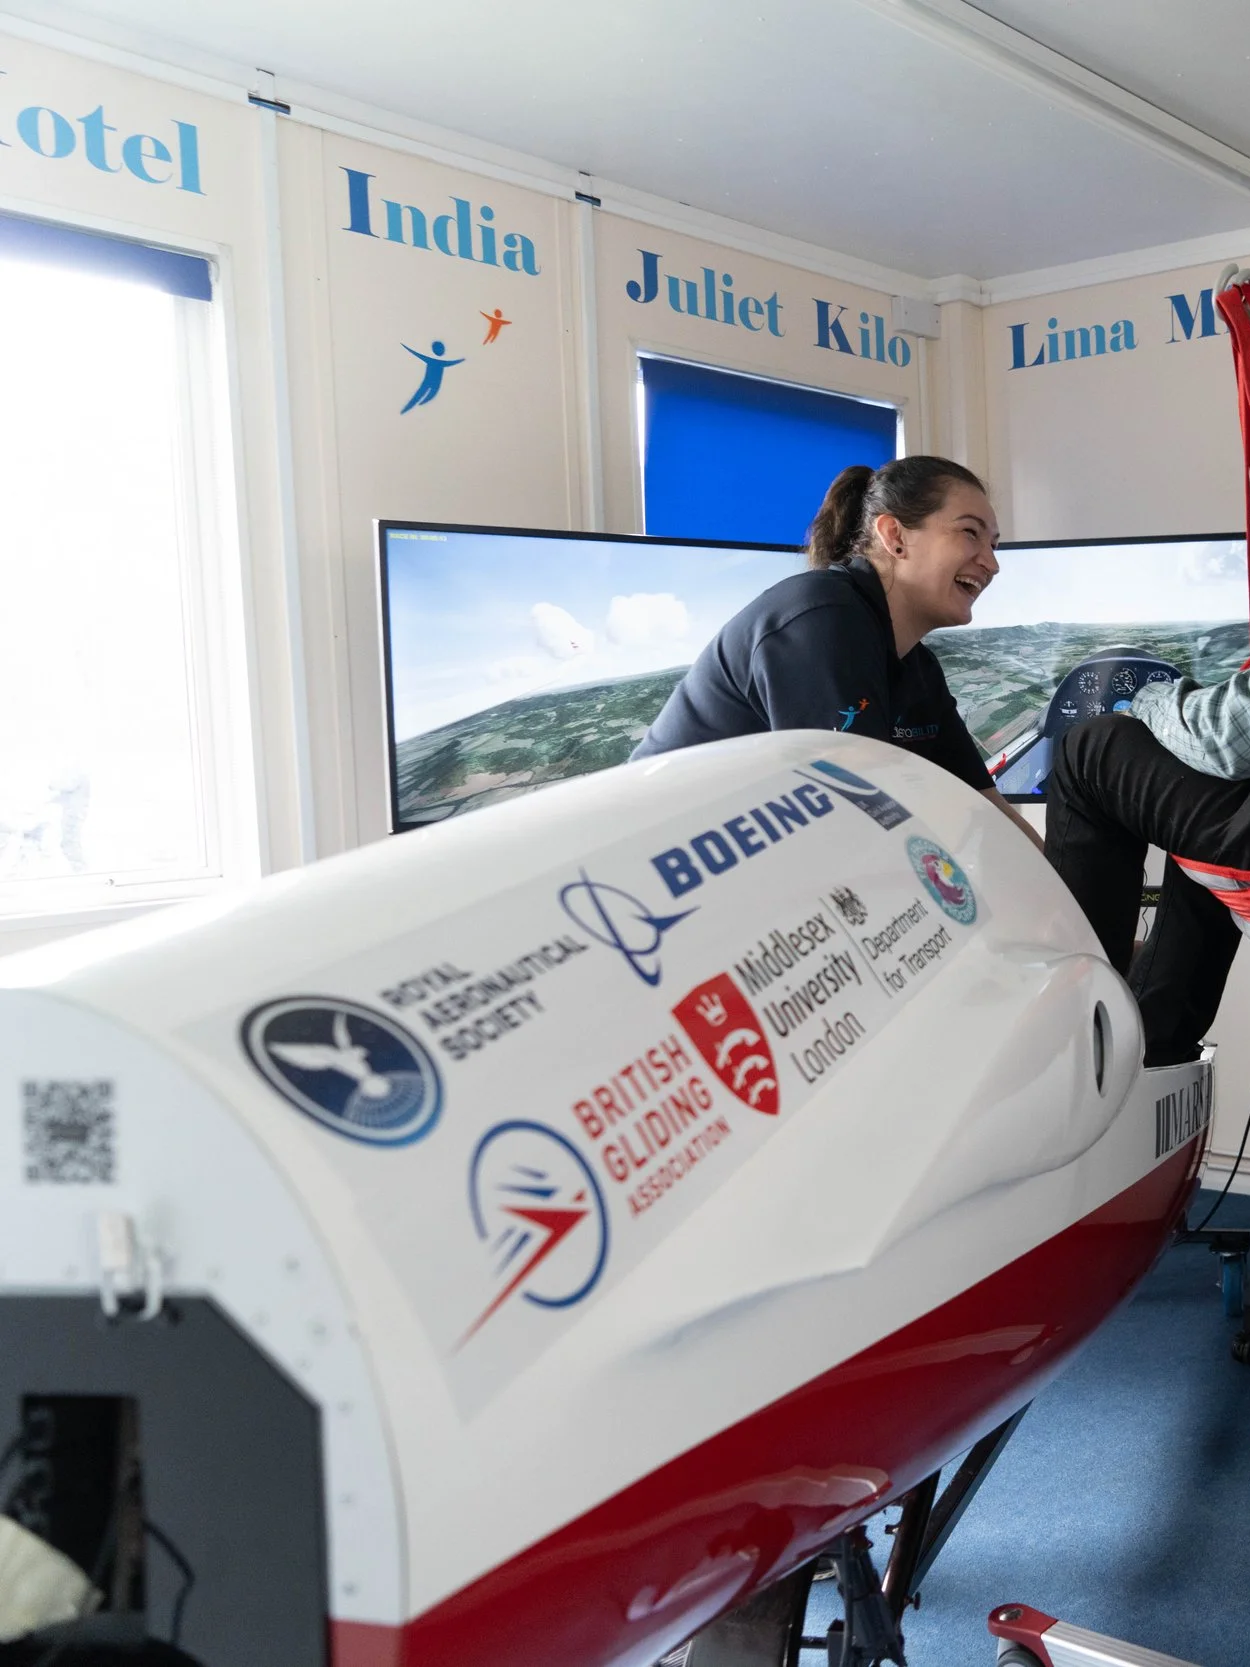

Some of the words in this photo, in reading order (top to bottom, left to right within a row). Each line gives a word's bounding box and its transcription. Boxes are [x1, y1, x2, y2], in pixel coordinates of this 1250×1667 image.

[0, 71, 207, 196] otel
[338, 166, 541, 276] India
[626, 249, 787, 338] Juliet
[812, 297, 912, 368] Kilo
[1007, 319, 1139, 371] Lima
[651, 783, 834, 899] BOEING
[734, 912, 836, 997] Middlesex
[862, 898, 929, 960] Department
[883, 970, 907, 993] for
[899, 924, 953, 977] Transport
[380, 962, 472, 1010] ROYAL
[421, 934, 589, 1032] AERONAUTICAL
[440, 989, 547, 1061] SOCIETY
[763, 951, 863, 1038] University
[571, 1033, 693, 1142] BRITISH
[790, 1012, 866, 1084] London
[602, 1076, 714, 1184] GLIDING
[627, 1114, 732, 1219] ASSOCIATION
